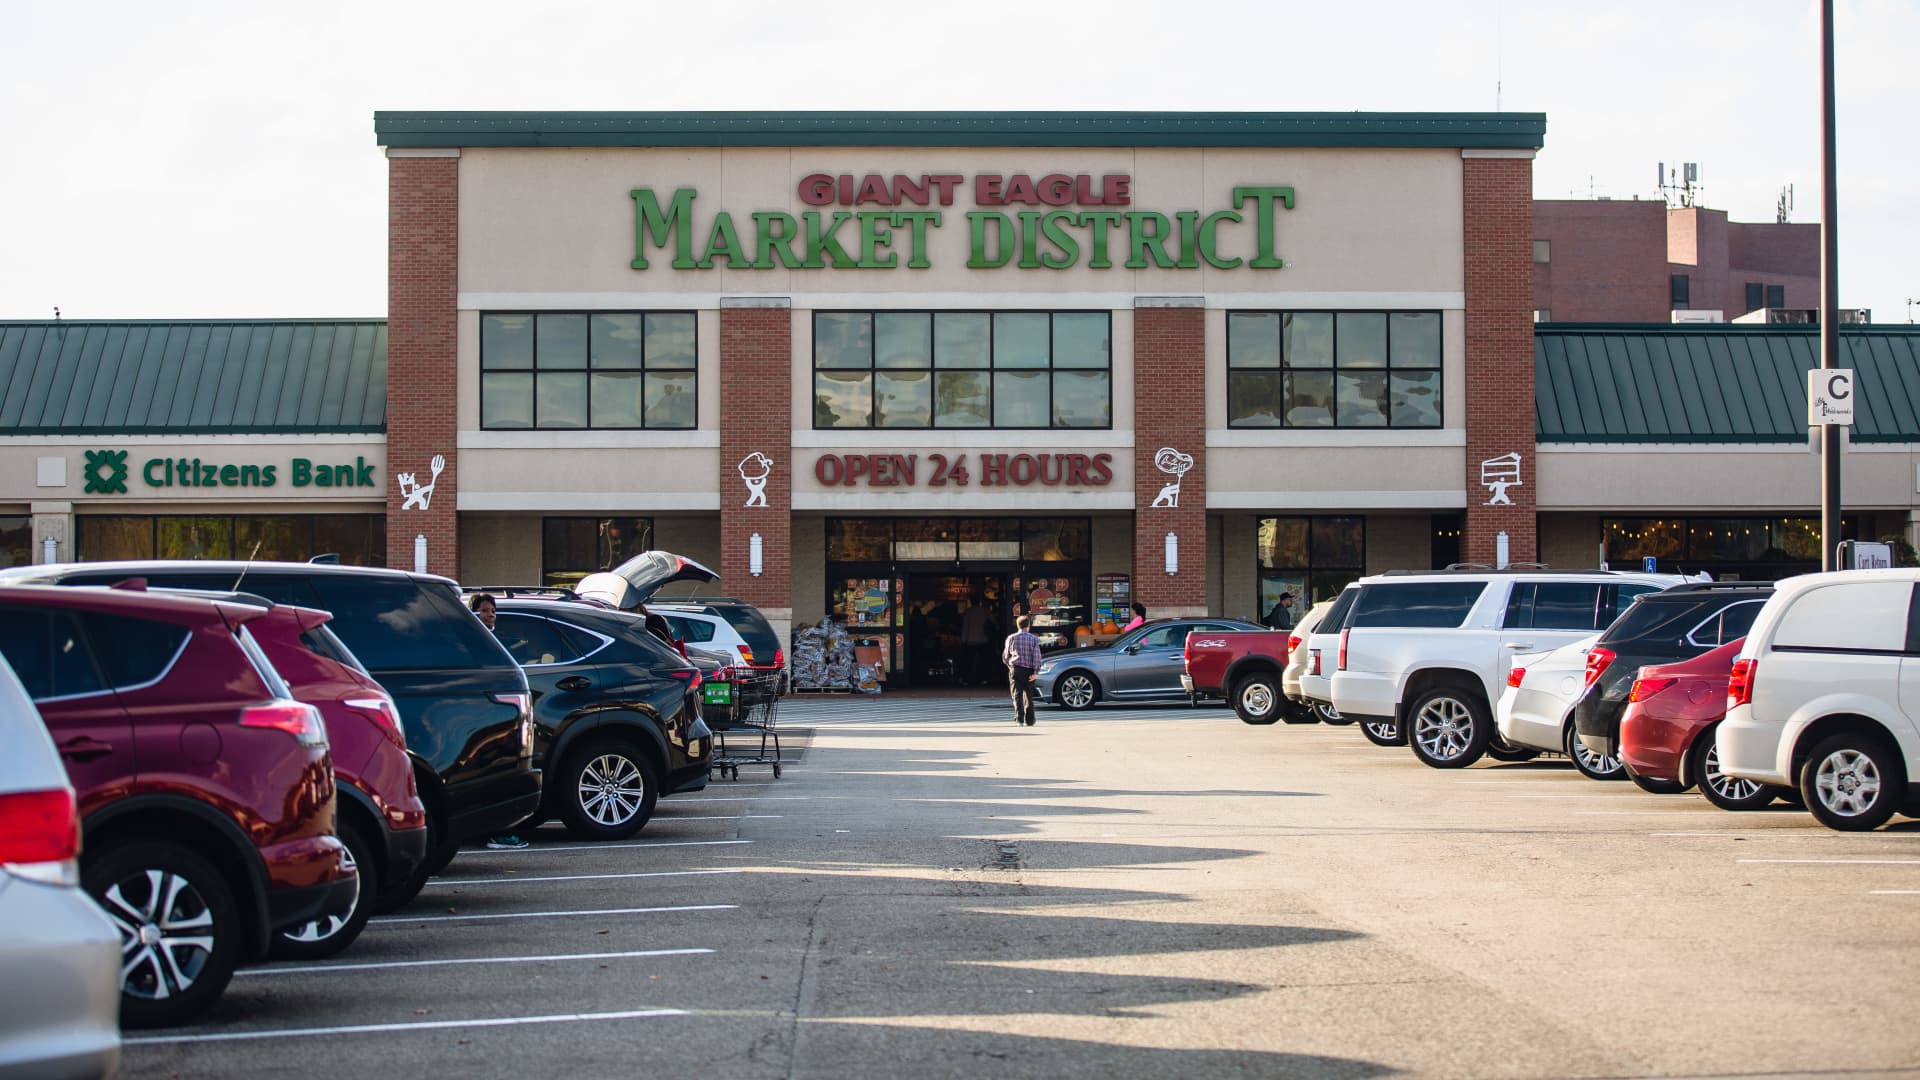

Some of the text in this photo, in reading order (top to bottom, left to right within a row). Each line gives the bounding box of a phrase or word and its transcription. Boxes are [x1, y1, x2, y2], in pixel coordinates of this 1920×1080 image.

[798, 173, 1131, 206] GIANT EAGLE
[630, 186, 1295, 270] MARKET DISTRICT
[1827, 374, 1849, 400] C
[143, 456, 376, 488] Citizens Bank
[815, 453, 1113, 487] OPEN 24 HOURS
